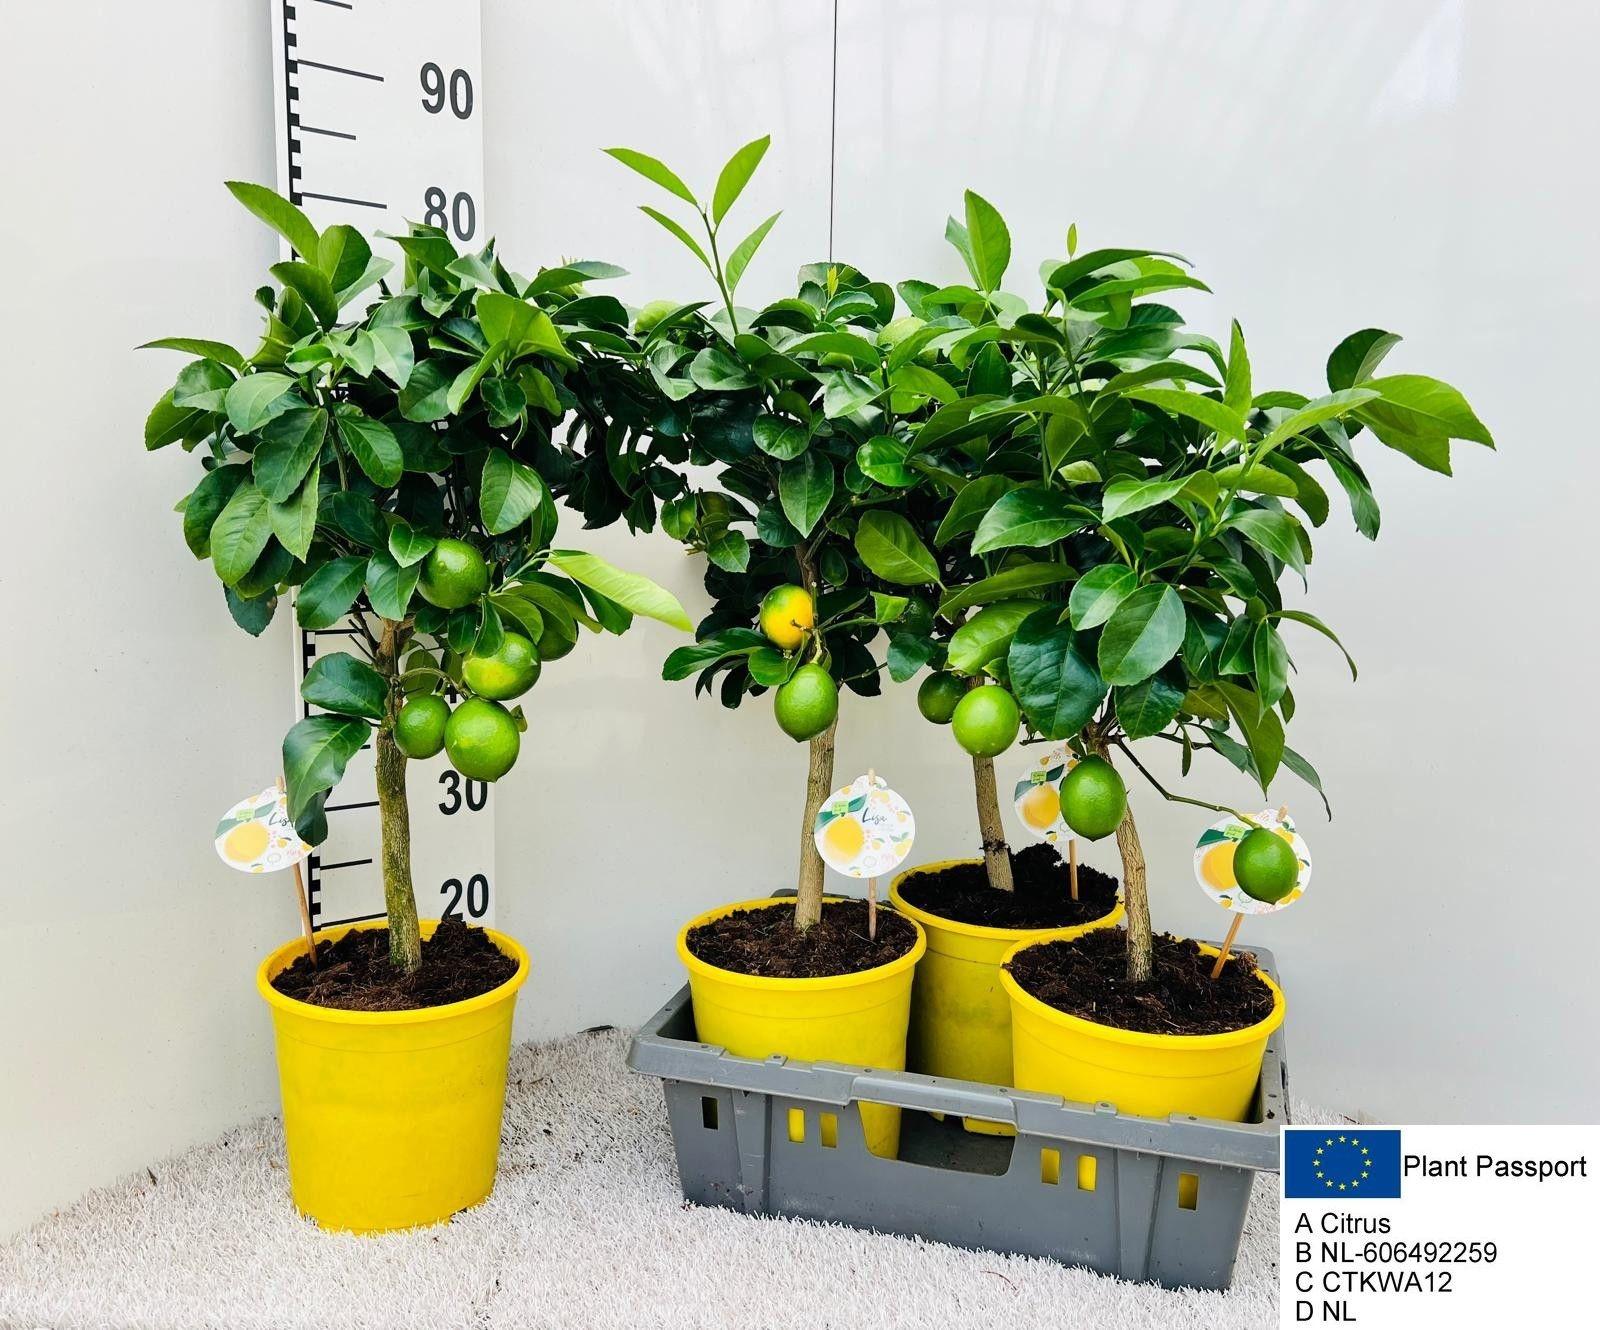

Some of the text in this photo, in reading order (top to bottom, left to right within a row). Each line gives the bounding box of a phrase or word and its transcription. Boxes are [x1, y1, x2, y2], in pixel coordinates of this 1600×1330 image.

[420, 61, 474, 120] 90
[423, 186, 476, 242] 80
[438, 769, 488, 816] 30
[440, 873, 489, 922] 20
